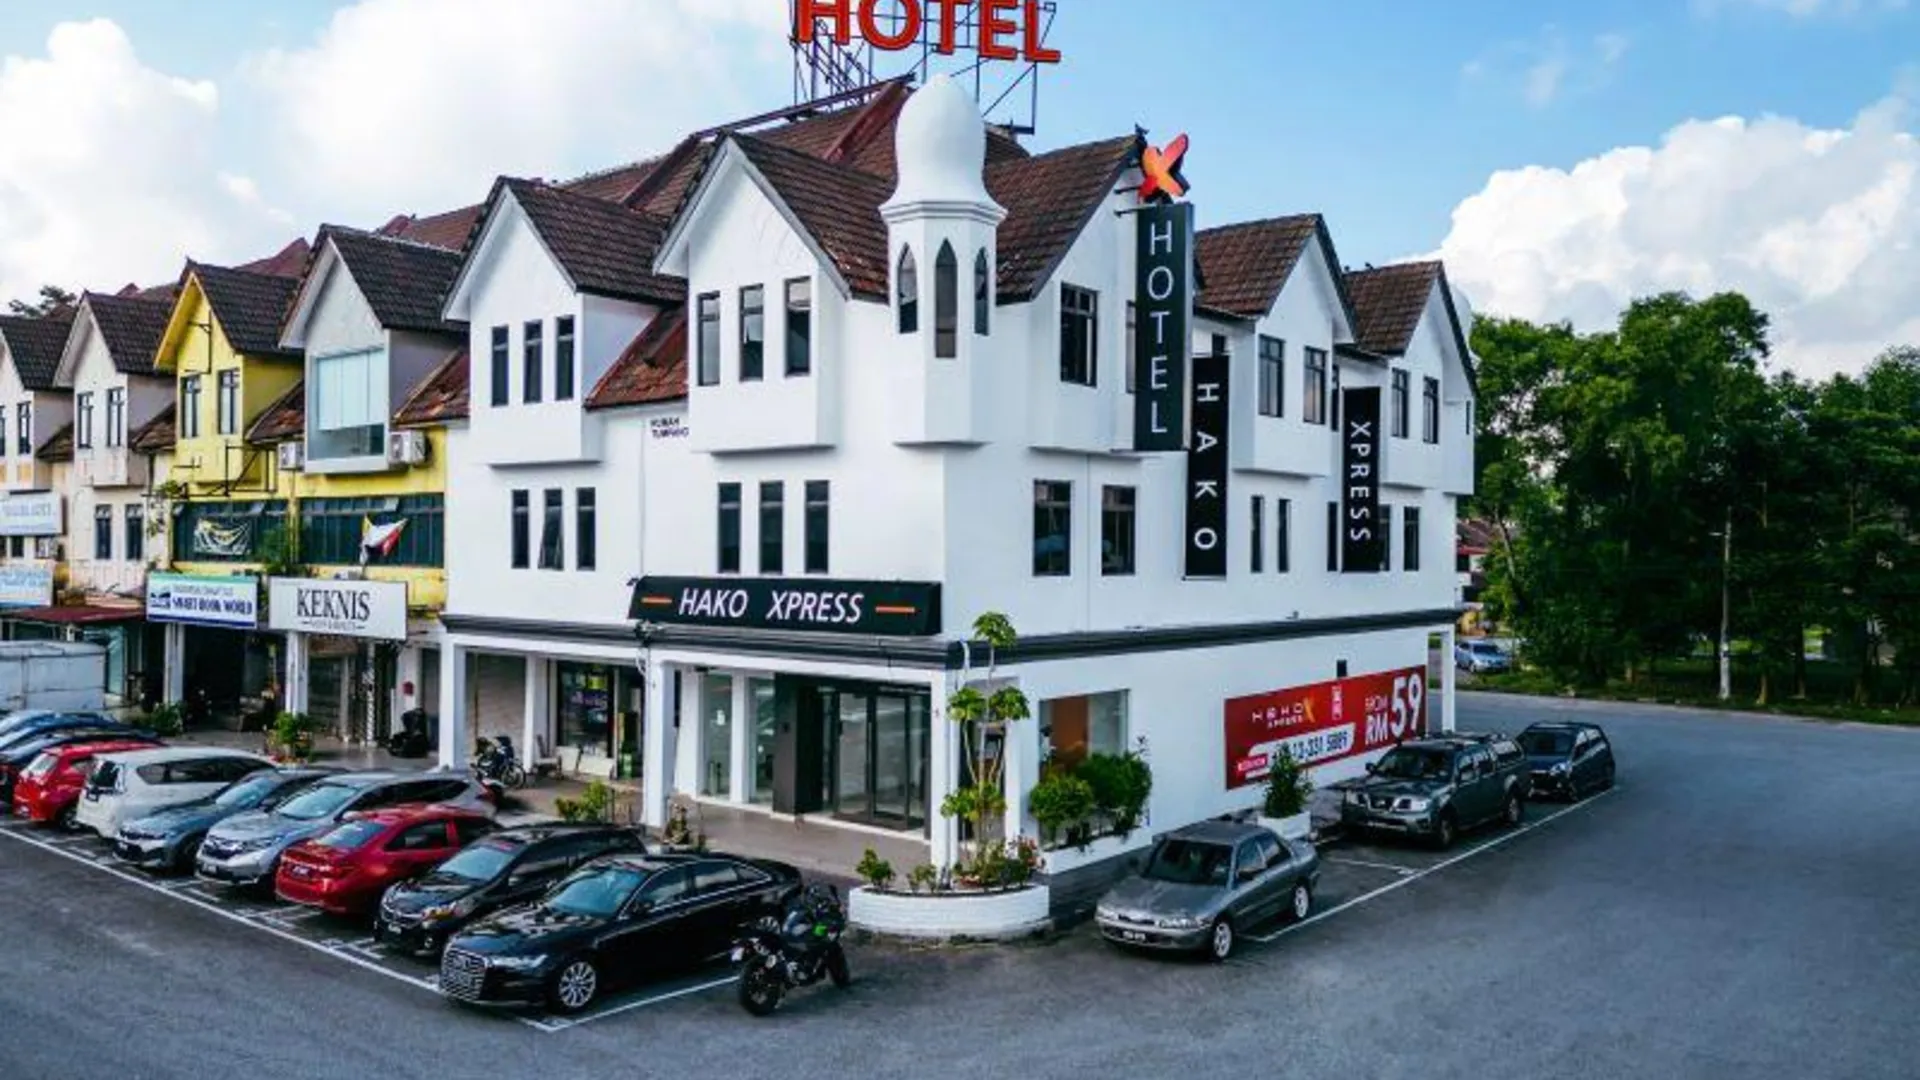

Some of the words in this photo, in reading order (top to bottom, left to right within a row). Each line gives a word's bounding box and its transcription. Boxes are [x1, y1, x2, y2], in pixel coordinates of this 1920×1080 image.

[796, 0, 1061, 62] HOTEL
[1147, 221, 1175, 434] HOTEL
[1194, 383, 1219, 551] HAKO
[1350, 421, 1372, 541] XPRESS
[296, 588, 371, 621] KEKNIS
[678, 587, 749, 618] HAKO
[765, 590, 864, 623] XPRESS
[1365, 712, 1389, 745] RM
[1391, 673, 1423, 738] 59
